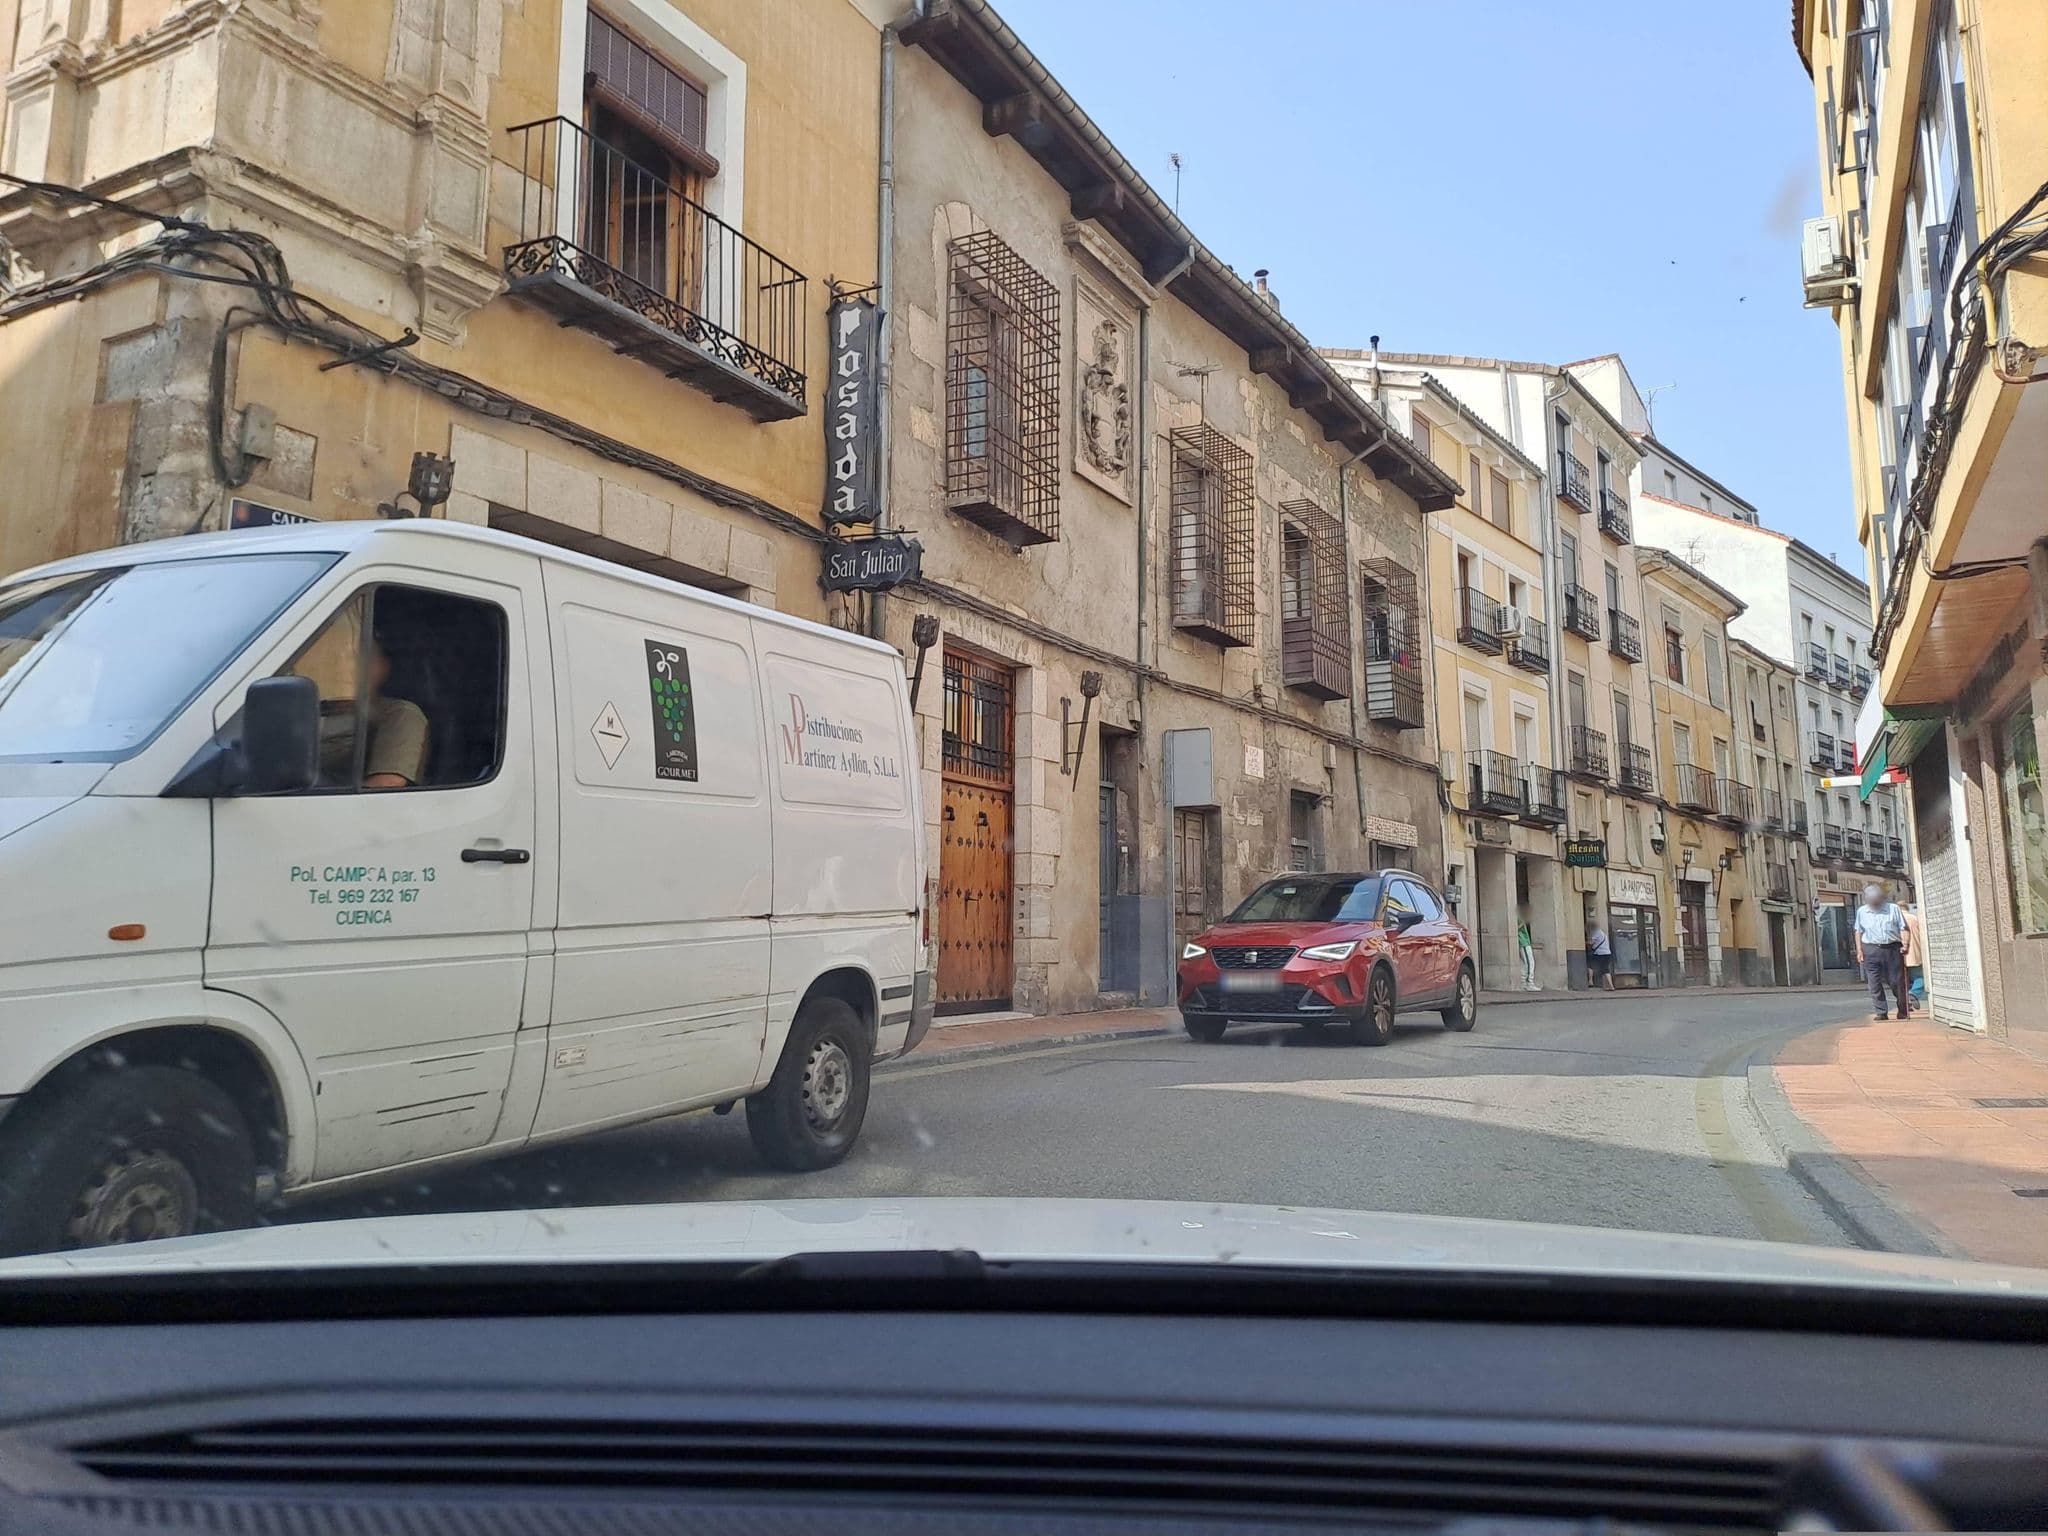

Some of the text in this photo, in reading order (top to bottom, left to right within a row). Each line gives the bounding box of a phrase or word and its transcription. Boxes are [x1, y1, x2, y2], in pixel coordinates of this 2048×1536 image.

[833, 307, 862, 513] Posada
[271, 511, 309, 525] CAL
[830, 547, 903, 579] San Julián
[788, 693, 864, 744] Distribuciones
[657, 766, 697, 779] GOURMET
[290, 866, 317, 882] Pol.
[392, 870, 417, 885] par.
[422, 867, 436, 882] 13
[309, 889, 420, 904] Tel. 969 232 167
[336, 910, 392, 925] CUENCA
